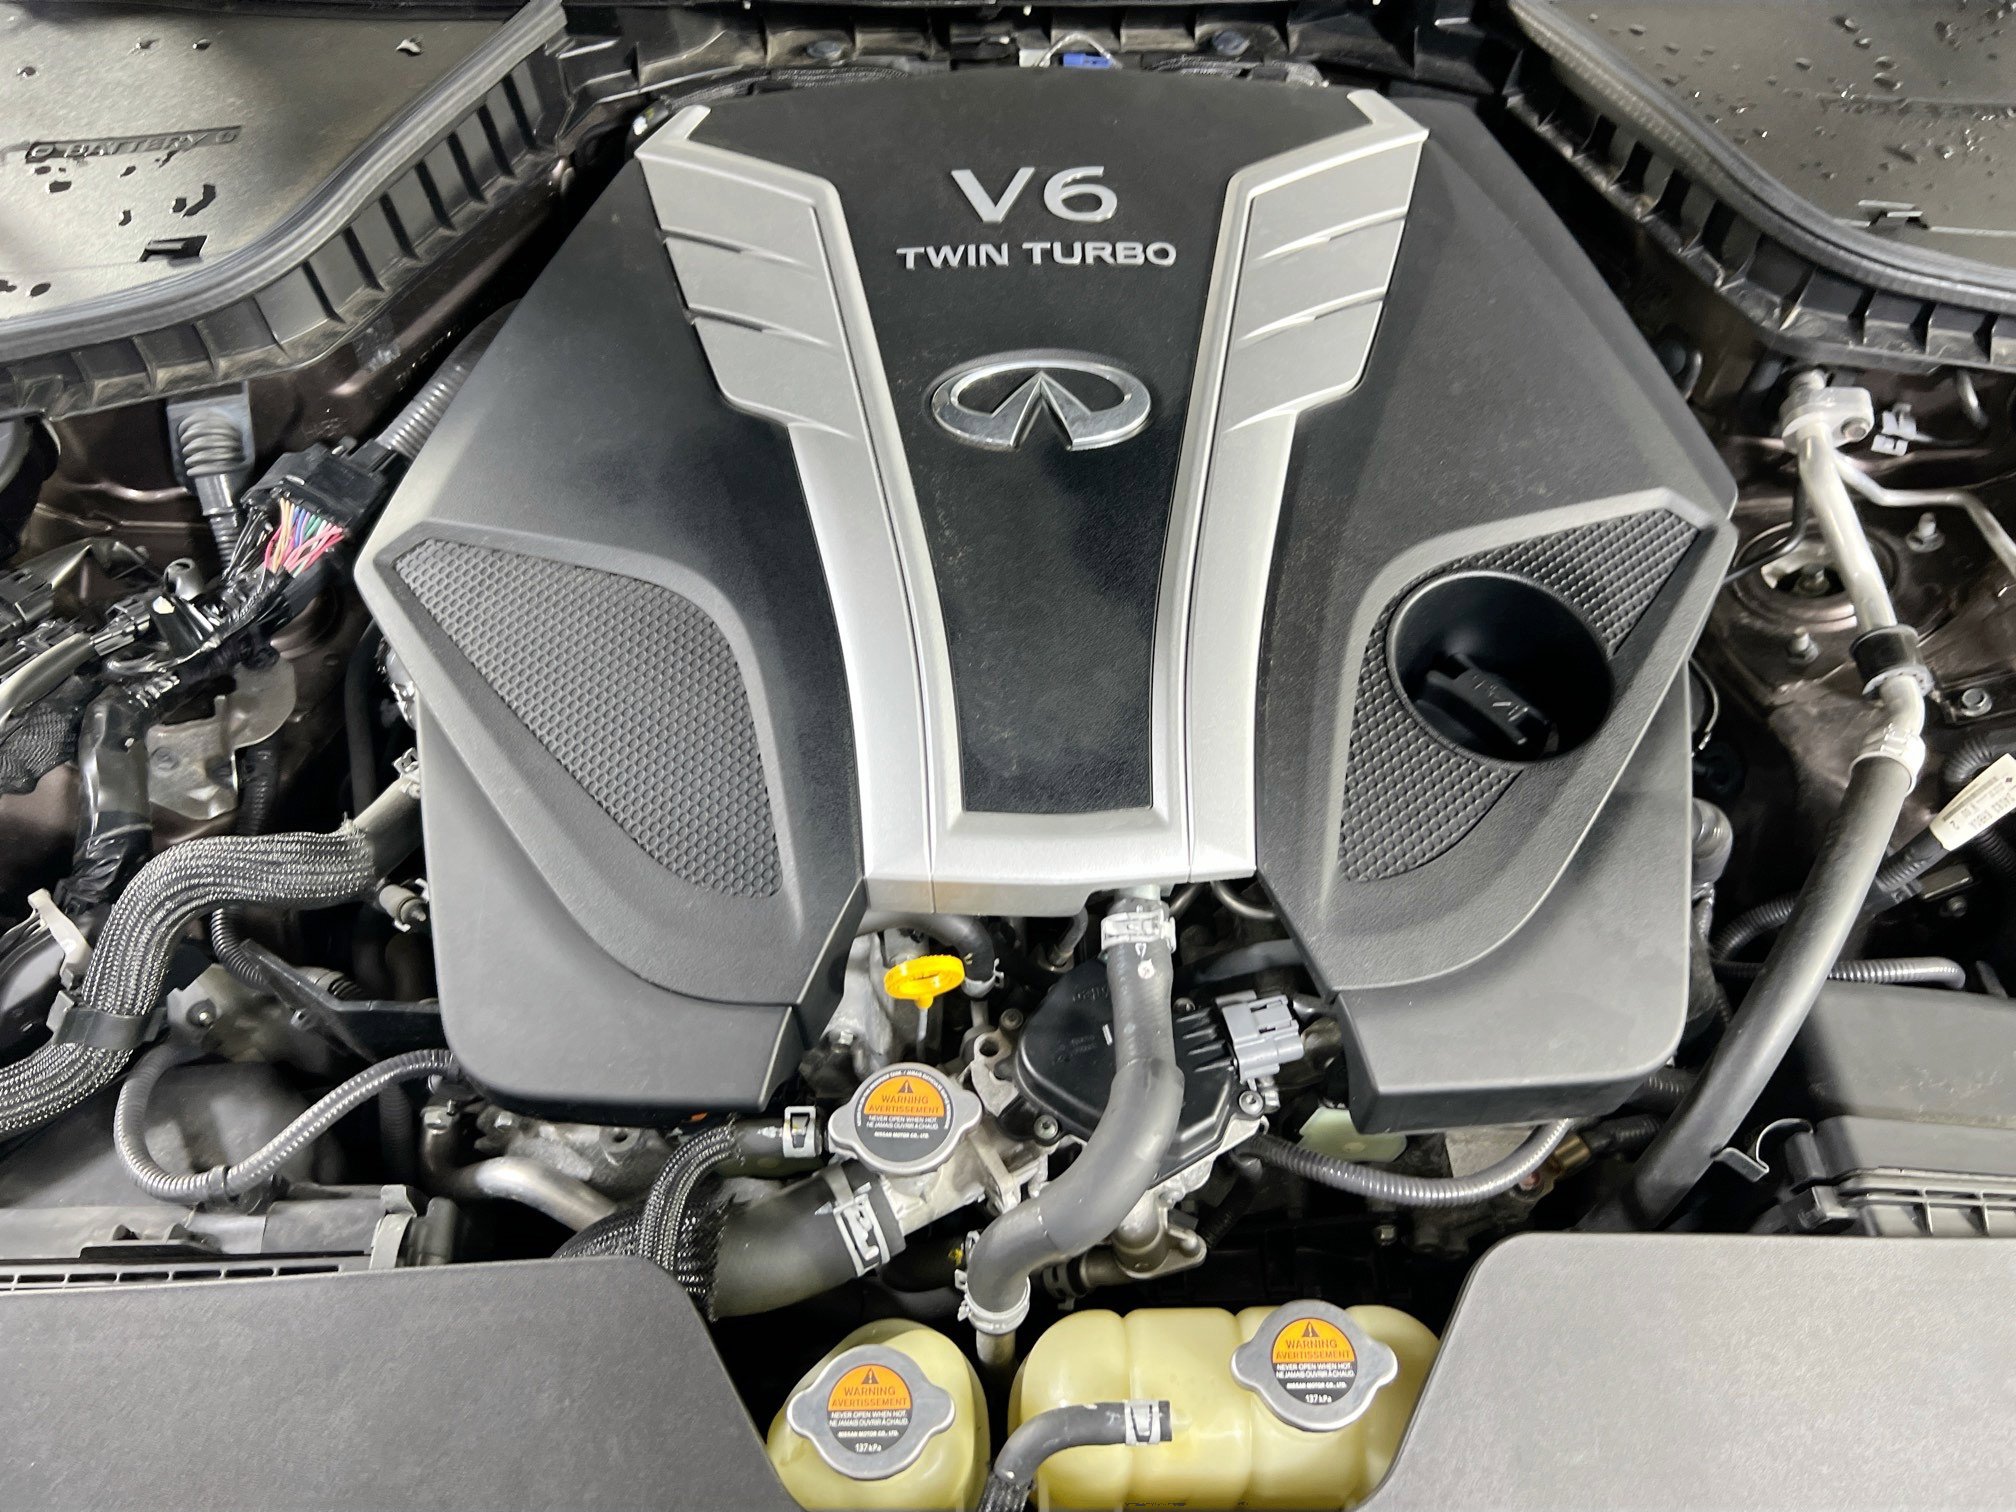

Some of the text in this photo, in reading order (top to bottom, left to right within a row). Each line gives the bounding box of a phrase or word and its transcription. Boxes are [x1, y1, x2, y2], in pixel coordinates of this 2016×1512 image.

[64, 133, 208, 157] BATTERY
[951, 165, 1118, 224] V6
[896, 241, 1177, 270] TWIN TURBO
[881, 1094, 929, 1104] WARNING
[868, 1105, 940, 1114] AVERTISSEMENT
[1286, 1340, 1337, 1349] WARNING
[1276, 1351, 1350, 1359] AVERTISSEMENT
[844, 1387, 896, 1396] WARNING
[832, 1398, 907, 1407] AVERTISSEMENT
[855, 1442, 882, 1453] 137 kPa
